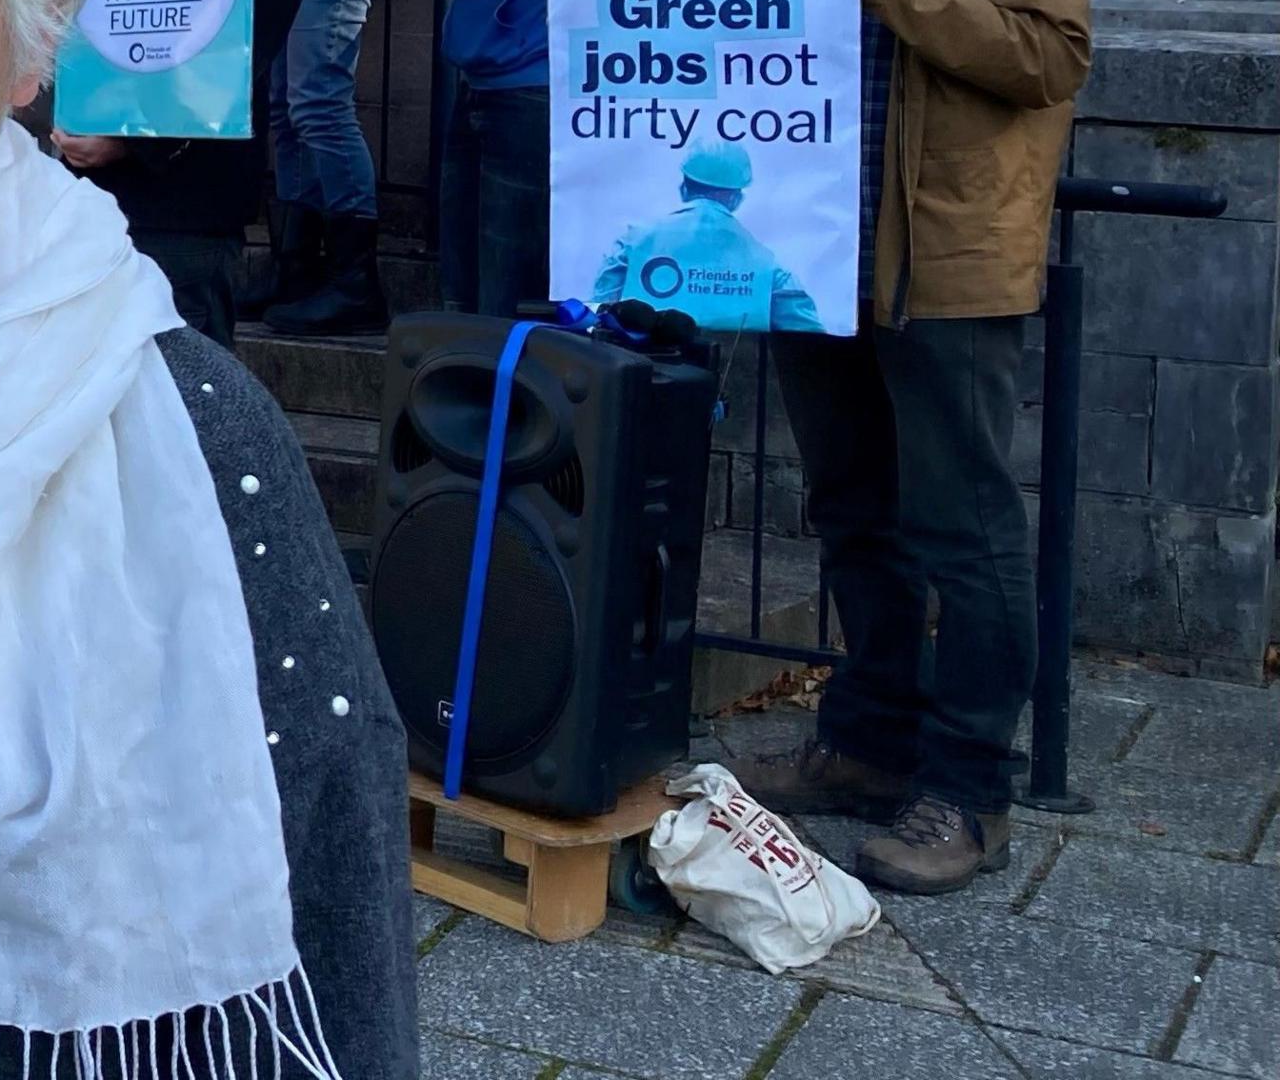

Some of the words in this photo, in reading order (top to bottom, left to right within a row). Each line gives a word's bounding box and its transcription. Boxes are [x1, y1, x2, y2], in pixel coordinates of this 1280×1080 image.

[110, 6, 191, 31] FUTURE
[581, 40, 708, 94] jobs
[723, 43, 818, 87] not
[571, 95, 700, 149] dirty
[716, 98, 832, 144] coal
[687, 268, 739, 283] Friends
[741, 269, 755, 283] of
[687, 282, 712, 296] the
[713, 284, 754, 297] Earth
